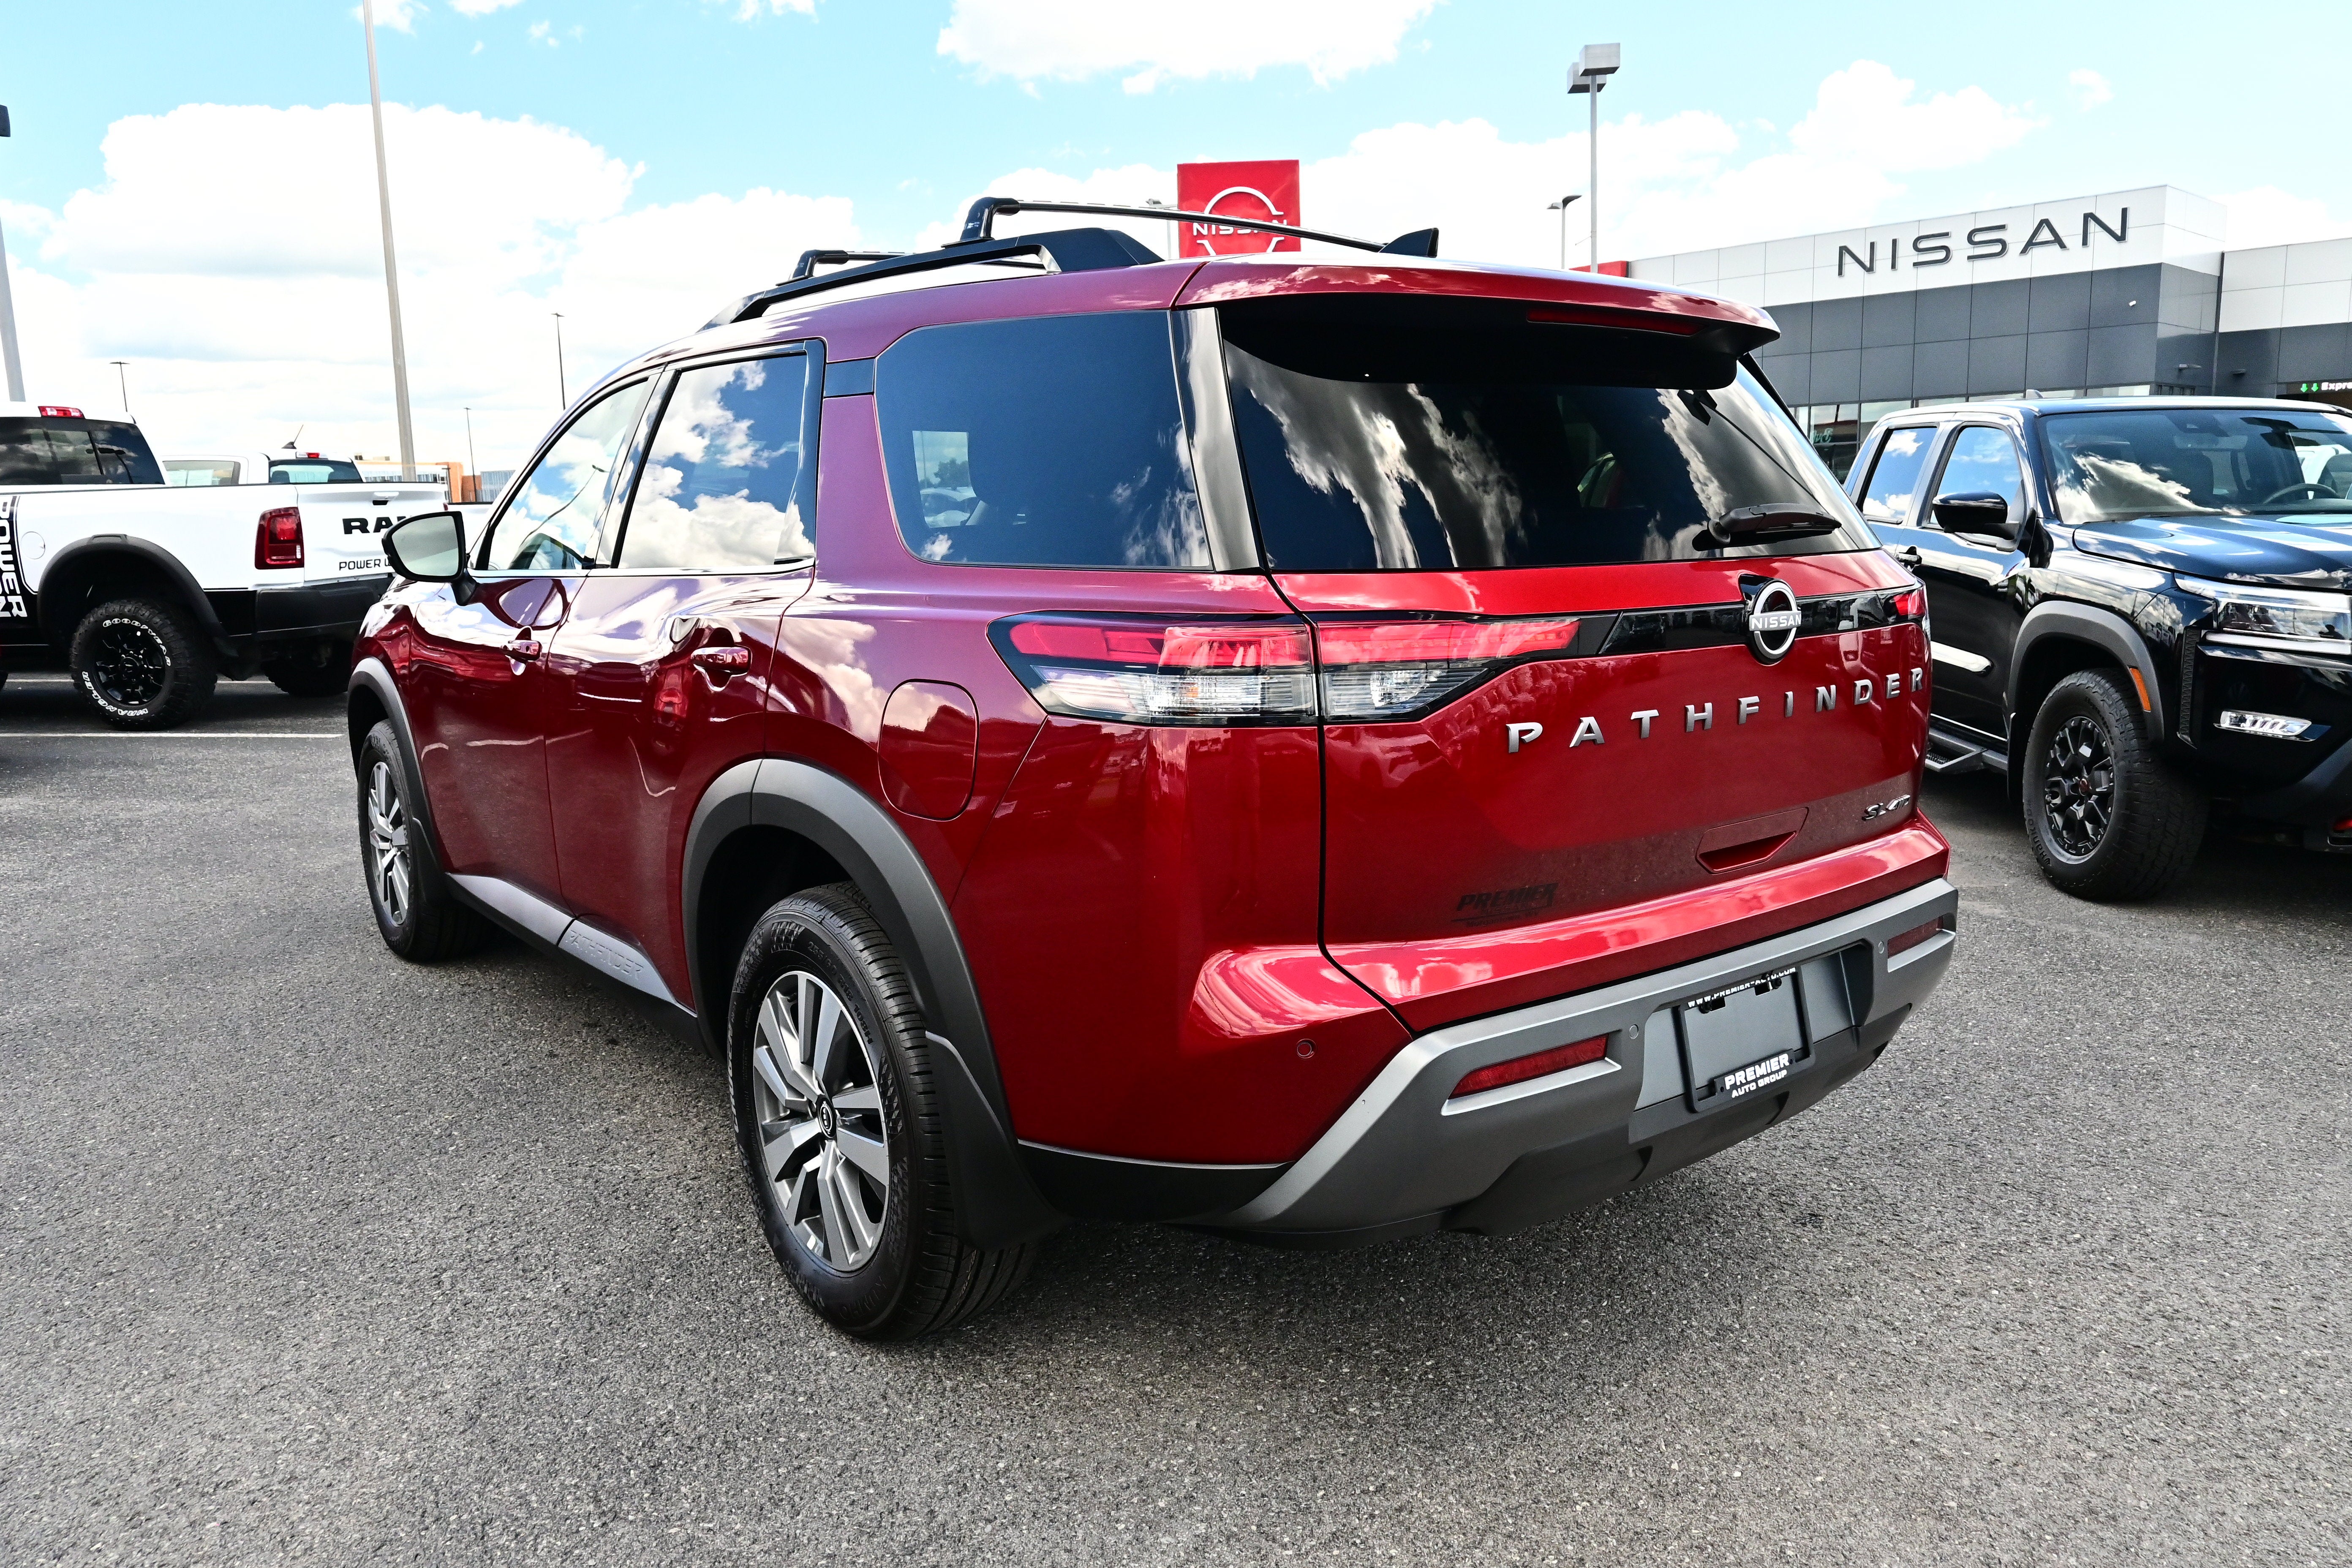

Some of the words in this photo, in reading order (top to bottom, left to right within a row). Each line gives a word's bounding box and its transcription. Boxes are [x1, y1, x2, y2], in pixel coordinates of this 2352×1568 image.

[1193, 219, 1287, 236] NIS
[1838, 207, 2130, 277] NISSAN
[343, 516, 406, 534] RA
[339, 558, 381, 570] POWER
[1751, 614, 1802, 629] NISSAN
[103, 618, 171, 666] GOODYEAR
[82, 671, 148, 716] WRANGLER
[1507, 667, 1923, 753] PATHFINDER
[1456, 882, 1560, 912] PREMIER
[1724, 1054, 1790, 1090] PREMIER
[1731, 1083, 1756, 1098] AUTO
[1758, 1069, 1787, 1089] GROUP
